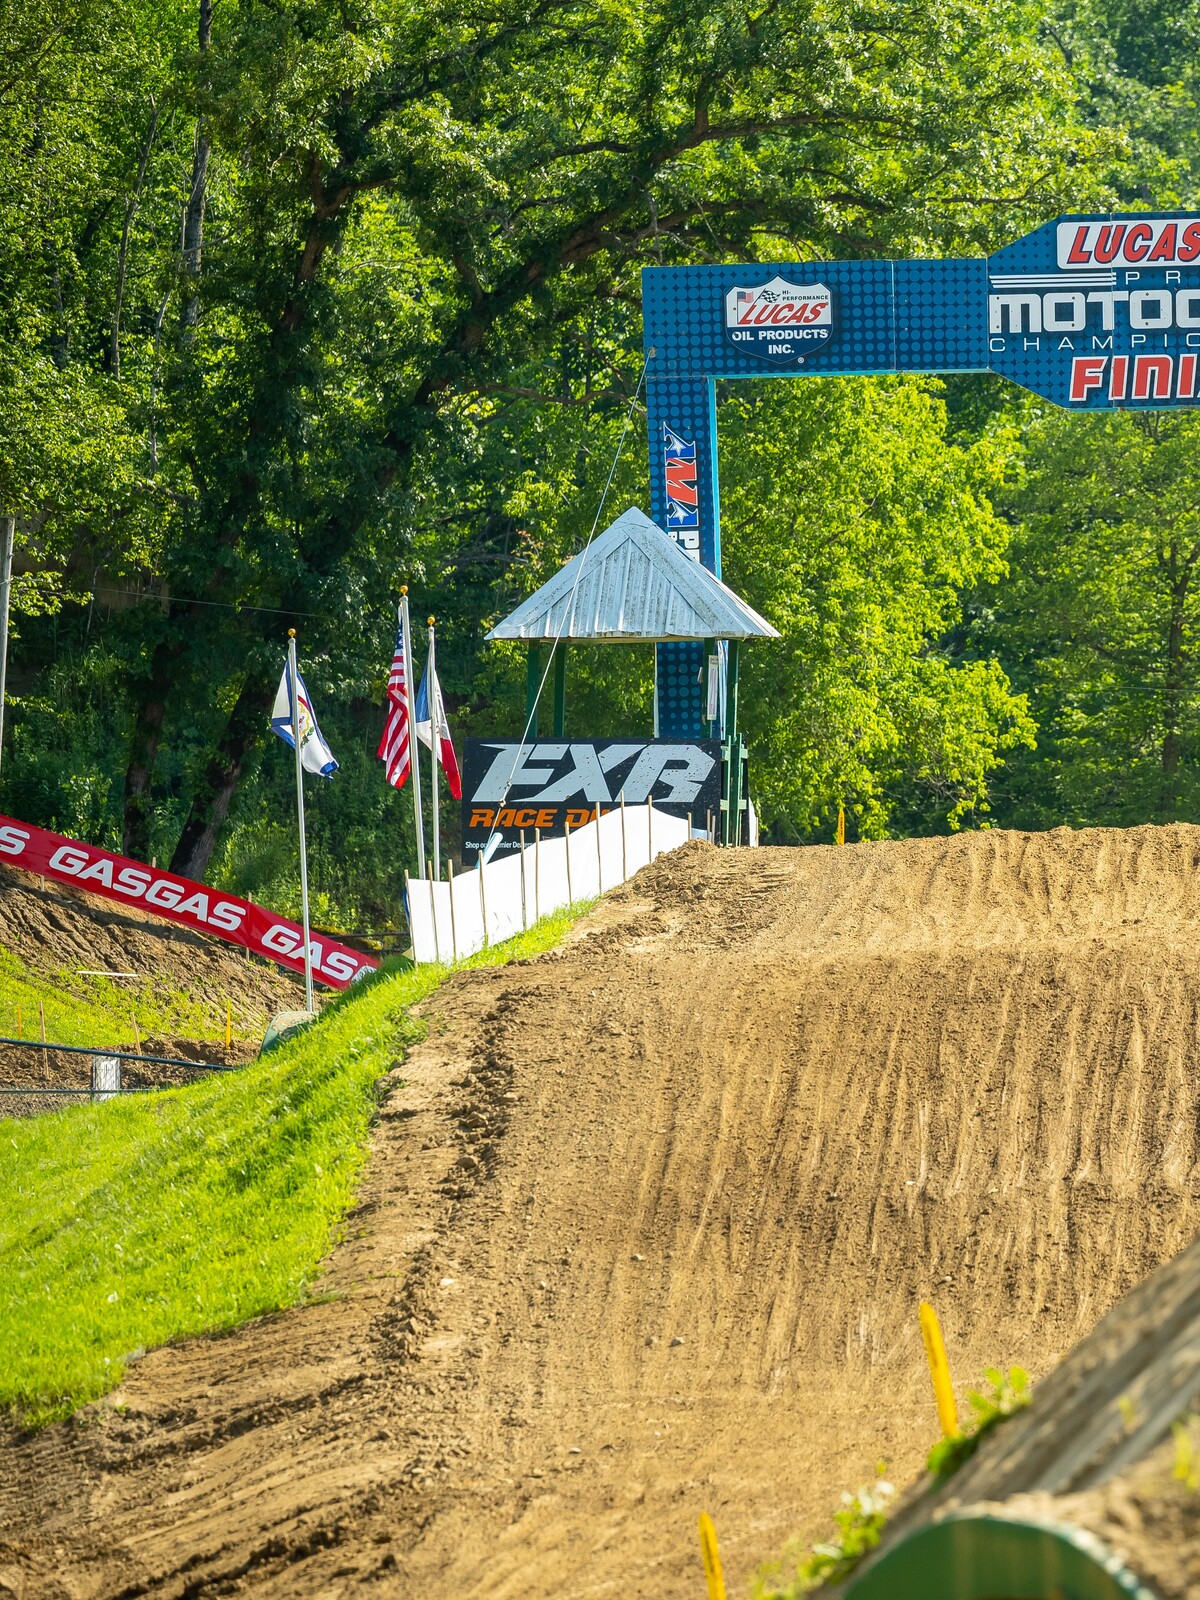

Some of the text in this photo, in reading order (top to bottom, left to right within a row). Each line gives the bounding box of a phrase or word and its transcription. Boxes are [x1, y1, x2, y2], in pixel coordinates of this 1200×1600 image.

[737, 302, 828, 325] LUCAS
[731, 329, 829, 341] OIL PRODUCTS
[768, 344, 795, 354] INC.
[471, 743, 716, 803] FXR
[469, 808, 558, 828] RACE
[465, 841, 479, 850] Shop
[49, 845, 247, 932] GASGAS
